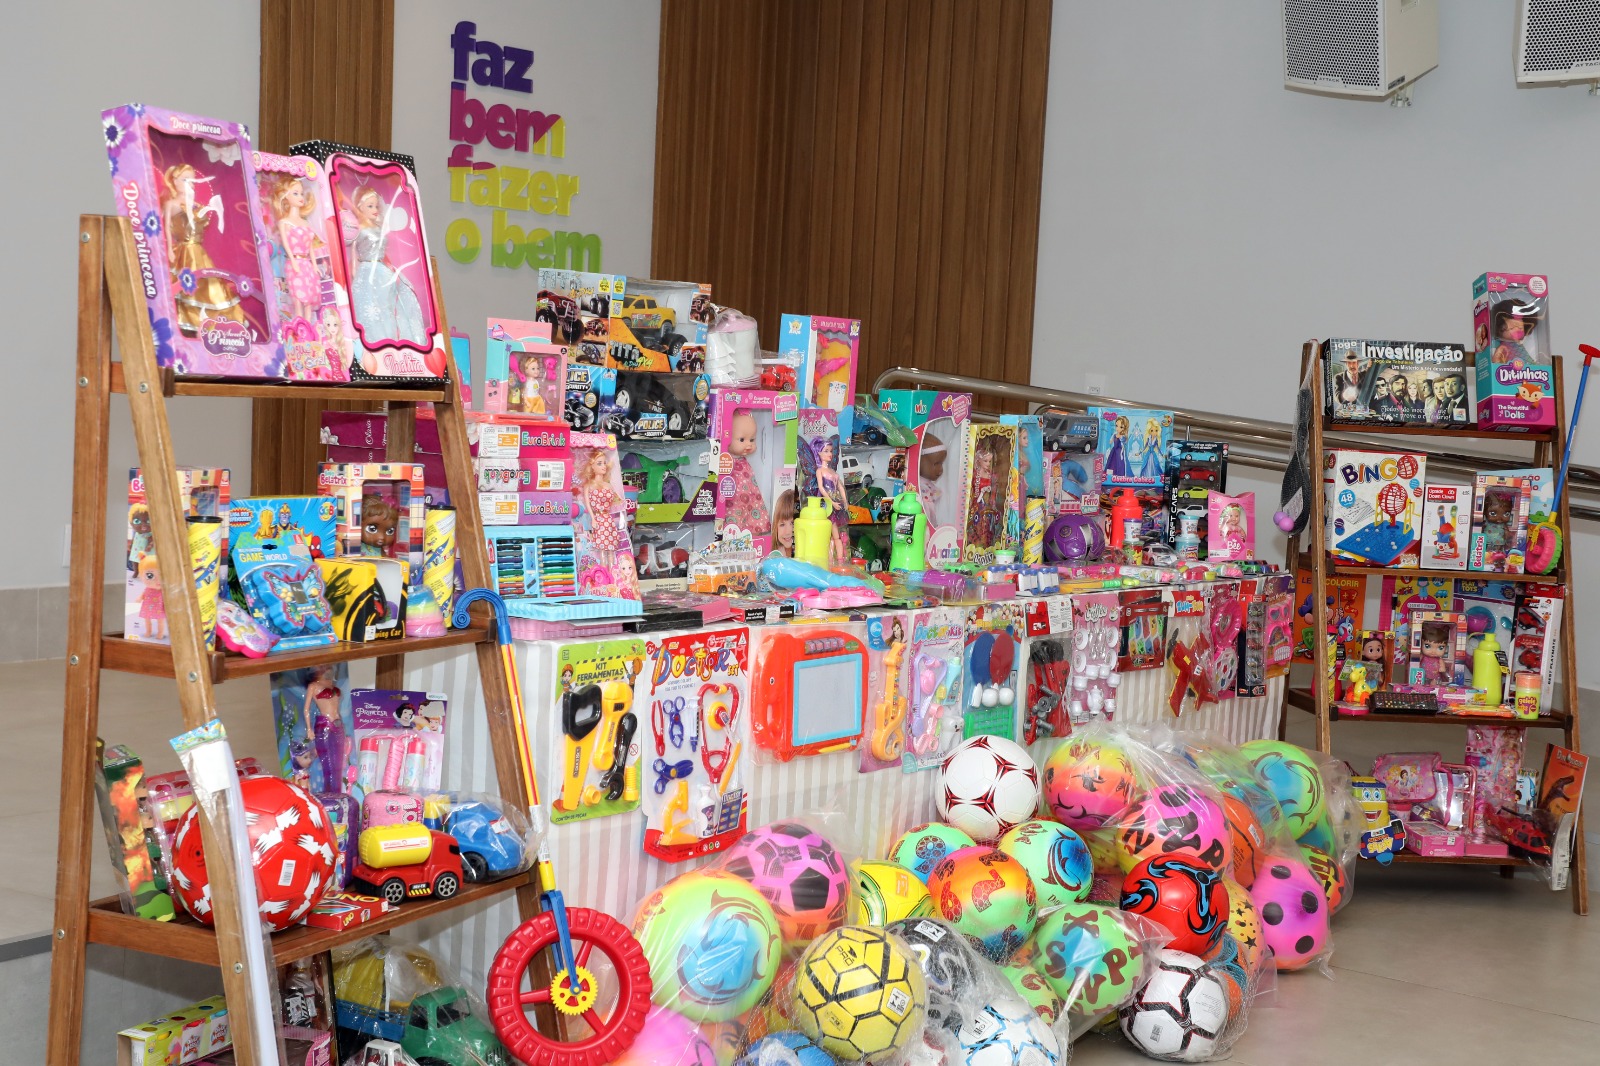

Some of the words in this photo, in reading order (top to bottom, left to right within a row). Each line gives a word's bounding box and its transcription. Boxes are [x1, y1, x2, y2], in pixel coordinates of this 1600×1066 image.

[451, 21, 534, 93] faz
[170, 116, 190, 130] Doce
[192, 122, 222, 135] princesa
[450, 82, 565, 158] bem
[448, 144, 580, 216] fazer
[123, 183, 141, 226] Doce
[134, 230, 157, 298] princesa
[445, 218, 482, 264] o
[492, 210, 602, 273] bem
[1361, 341, 1464, 365] Investigação
[1500, 369, 1548, 381] Ditinhas
[1503, 410, 1525, 419] Dolls
[638, 420, 664, 430] POLICE
[522, 432, 565, 447] EuroBrink
[319, 473, 347, 486] Belatrix
[484, 469, 530, 485] EuroBrink
[1341, 493, 1354, 503] 48
[524, 500, 569, 515] EuroBrink
[1169, 513, 1177, 543] DRIFT
[239, 552, 264, 562] GAME
[265, 553, 287, 561] WORLD
[1326, 578, 1359, 588] COLORIR
[391, 628, 402, 637] Car
[595, 662, 607, 671] KIT
[577, 668, 624, 682] FERRAMENTAS
[323, 892, 380, 903] UNO
[343, 911, 354, 927] UNO
